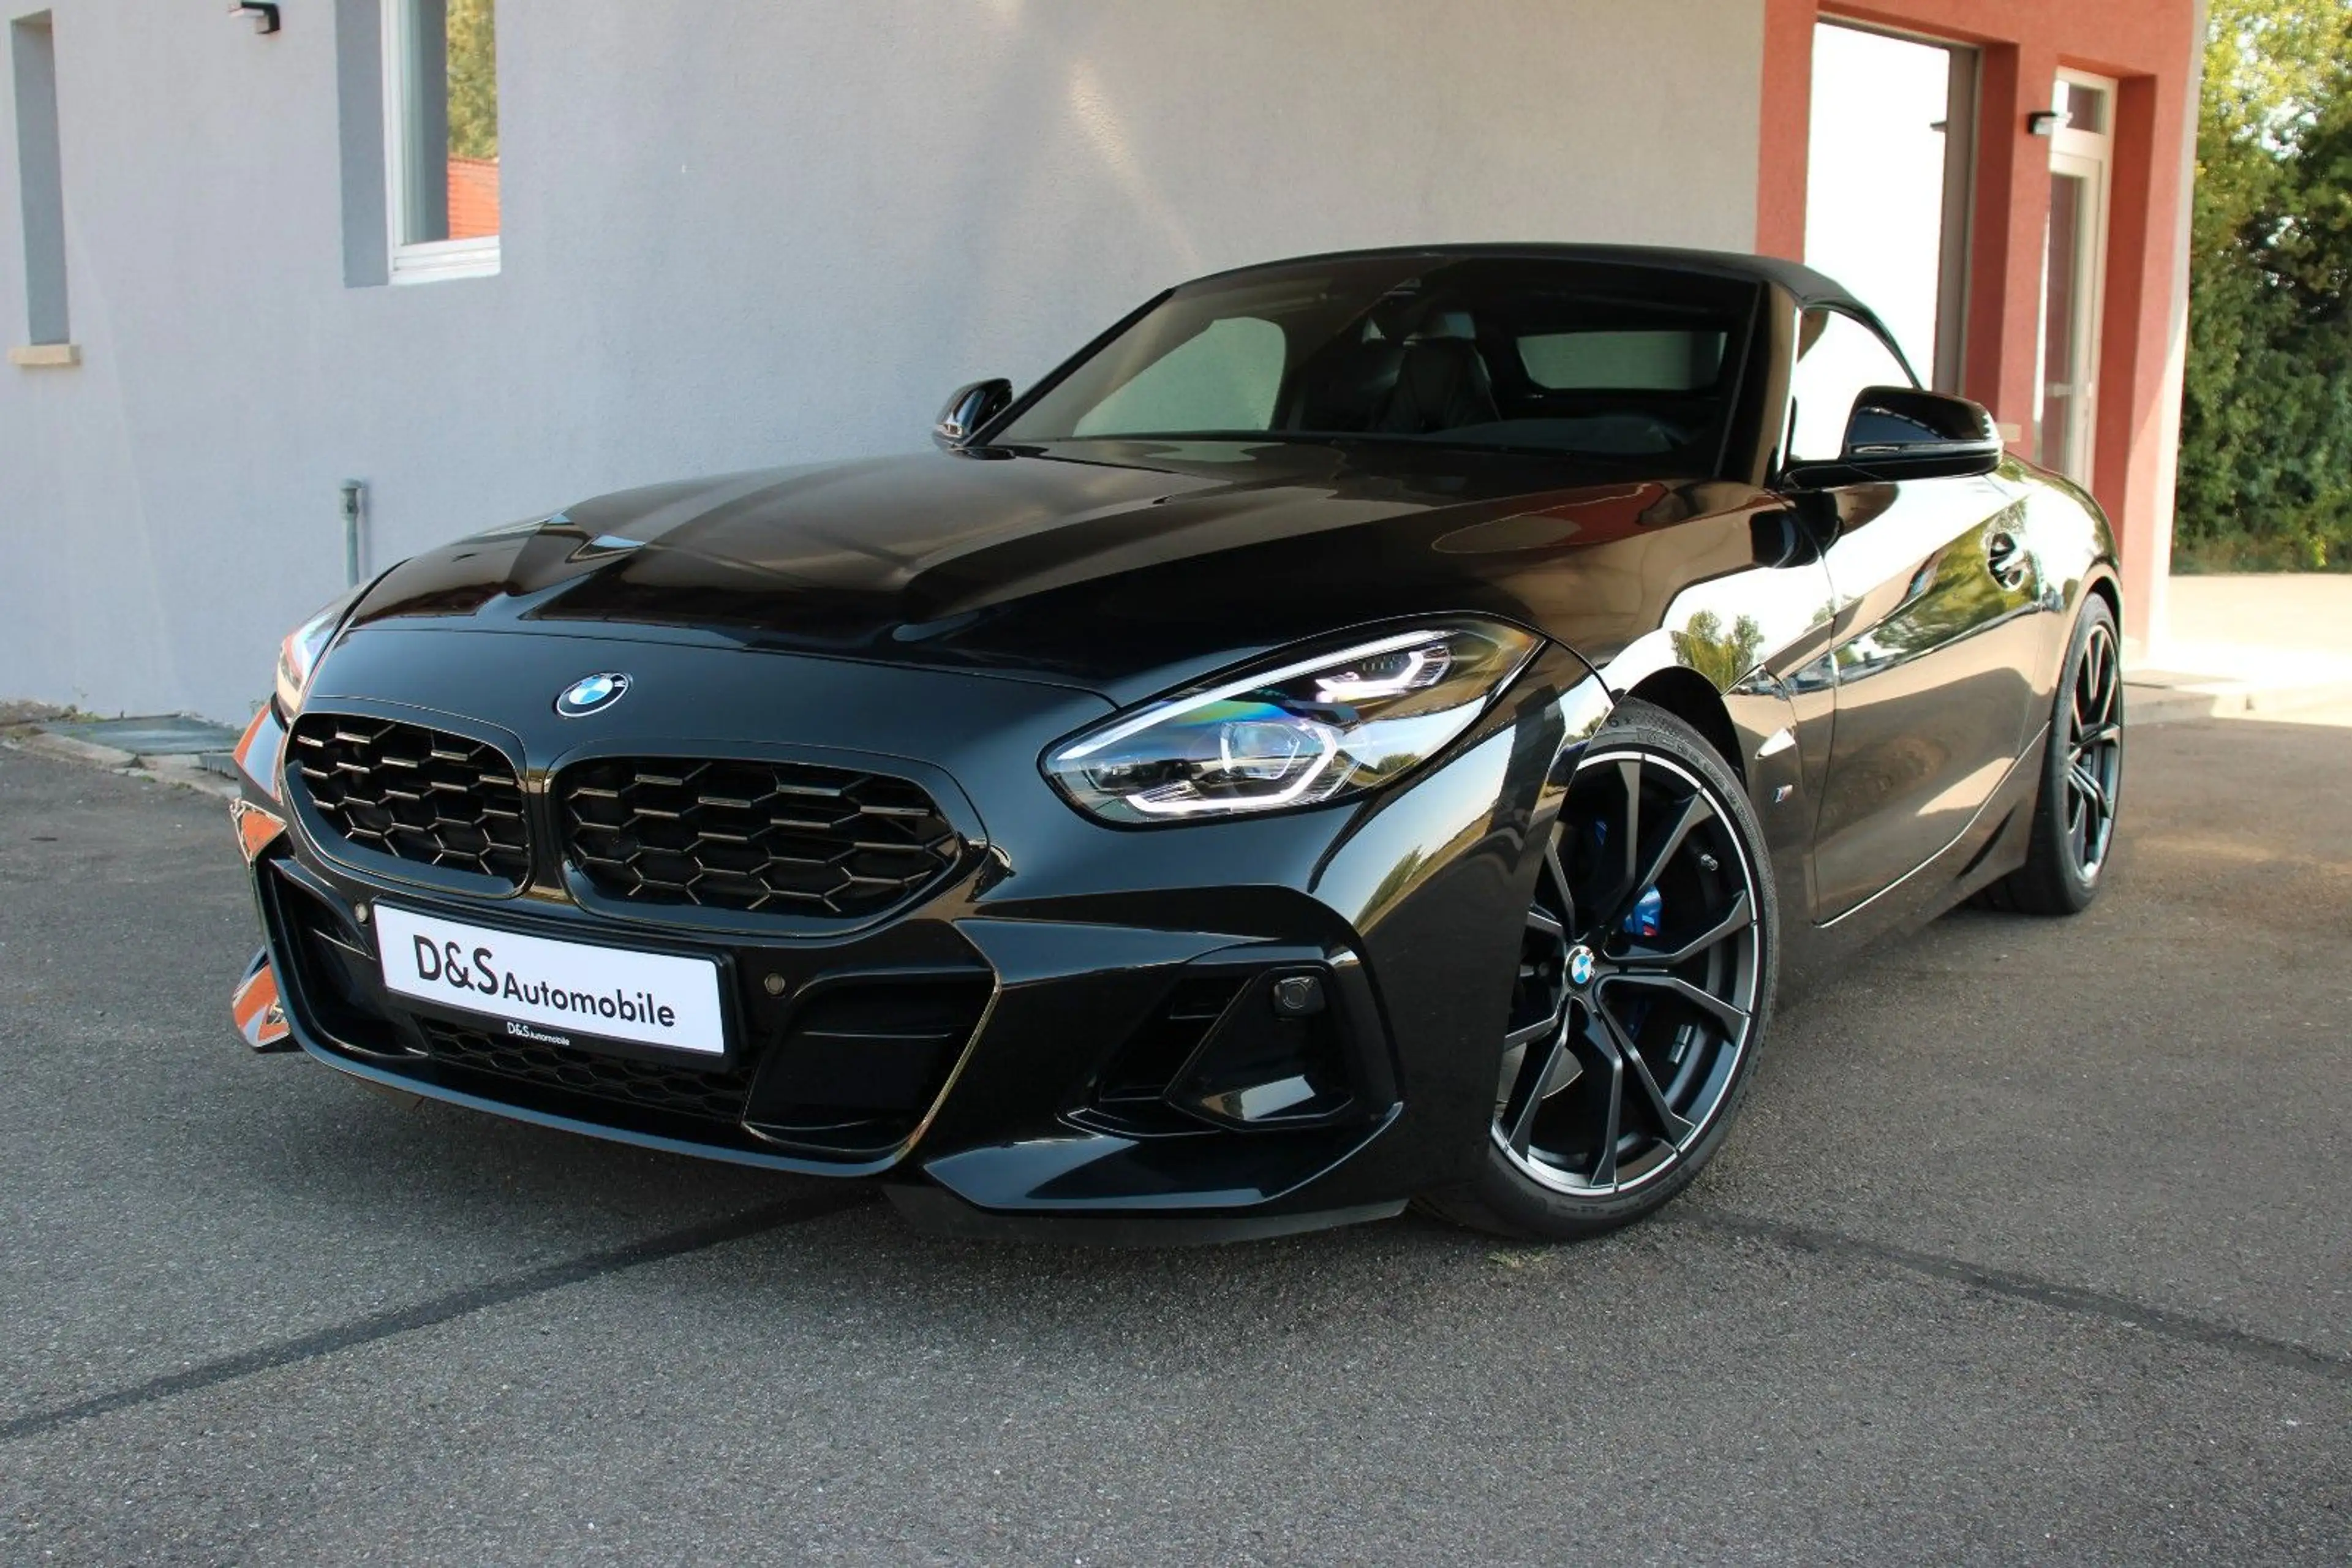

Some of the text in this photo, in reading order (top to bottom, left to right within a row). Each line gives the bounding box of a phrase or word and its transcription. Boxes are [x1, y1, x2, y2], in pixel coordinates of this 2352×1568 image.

[413, 934, 675, 1027] D&S Automobile
[507, 1021, 530, 1037] D&S
